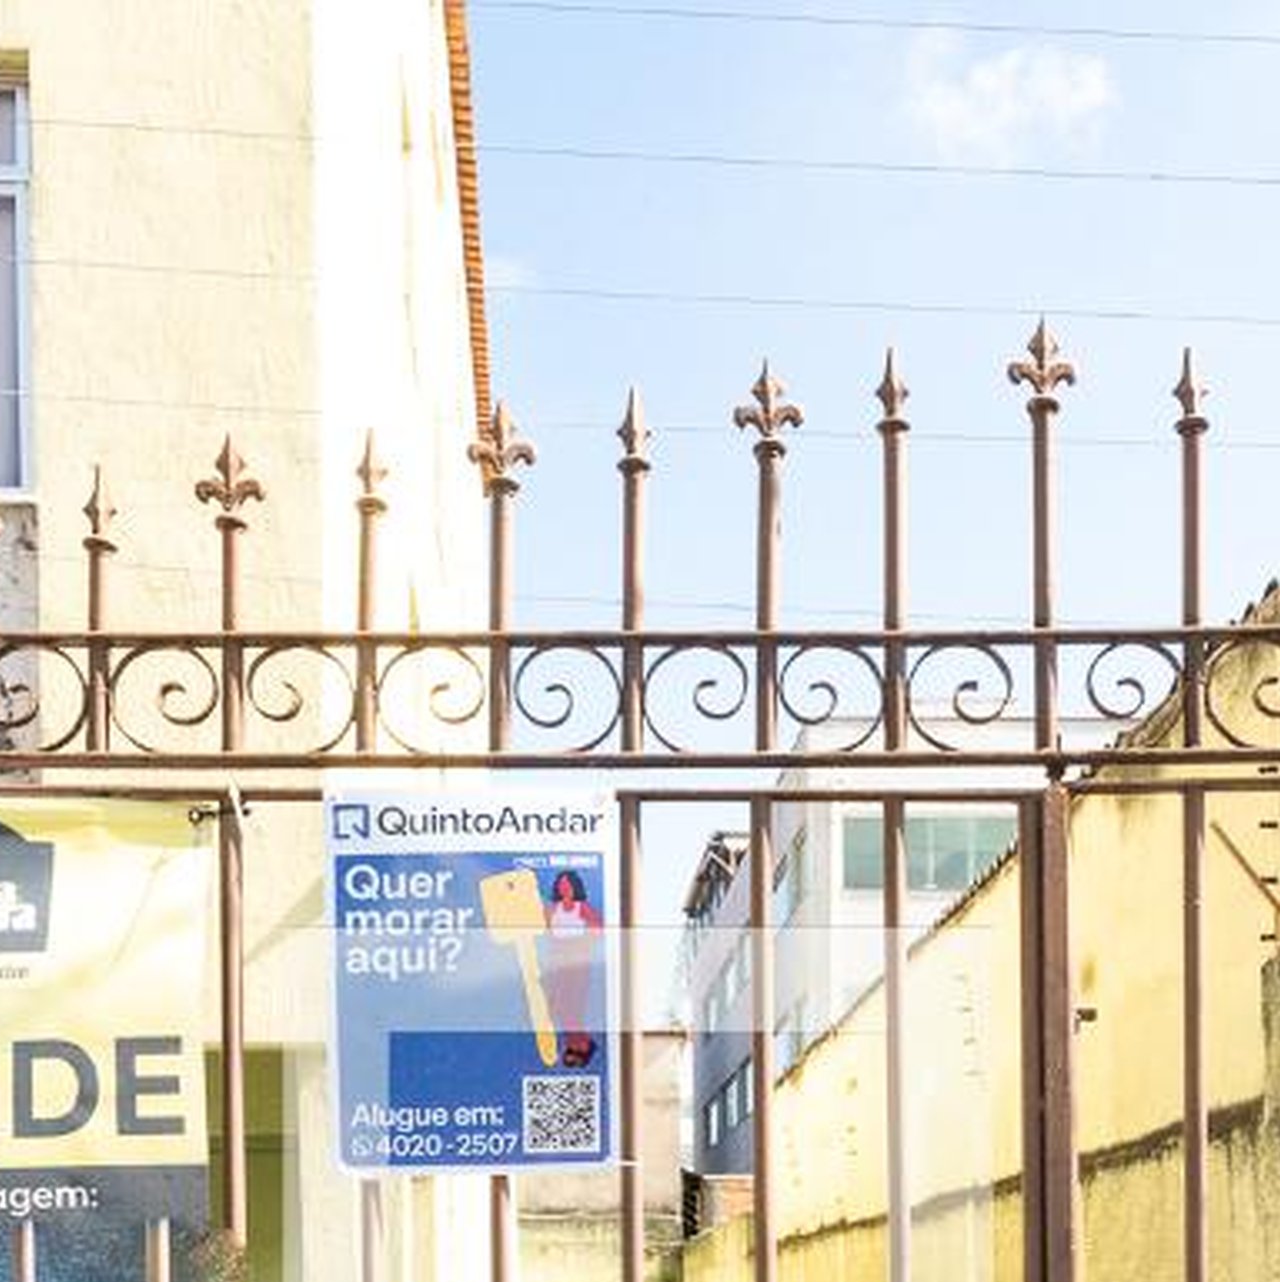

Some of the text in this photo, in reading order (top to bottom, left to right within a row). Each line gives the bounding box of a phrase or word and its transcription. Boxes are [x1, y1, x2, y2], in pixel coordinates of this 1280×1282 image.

[377, 806, 603, 836] QuintoAndar
[345, 865, 453, 901] Quer
[345, 907, 474, 936] morar
[345, 939, 463, 980] aqui?
[351, 1103, 504, 1132] Alugue em:
